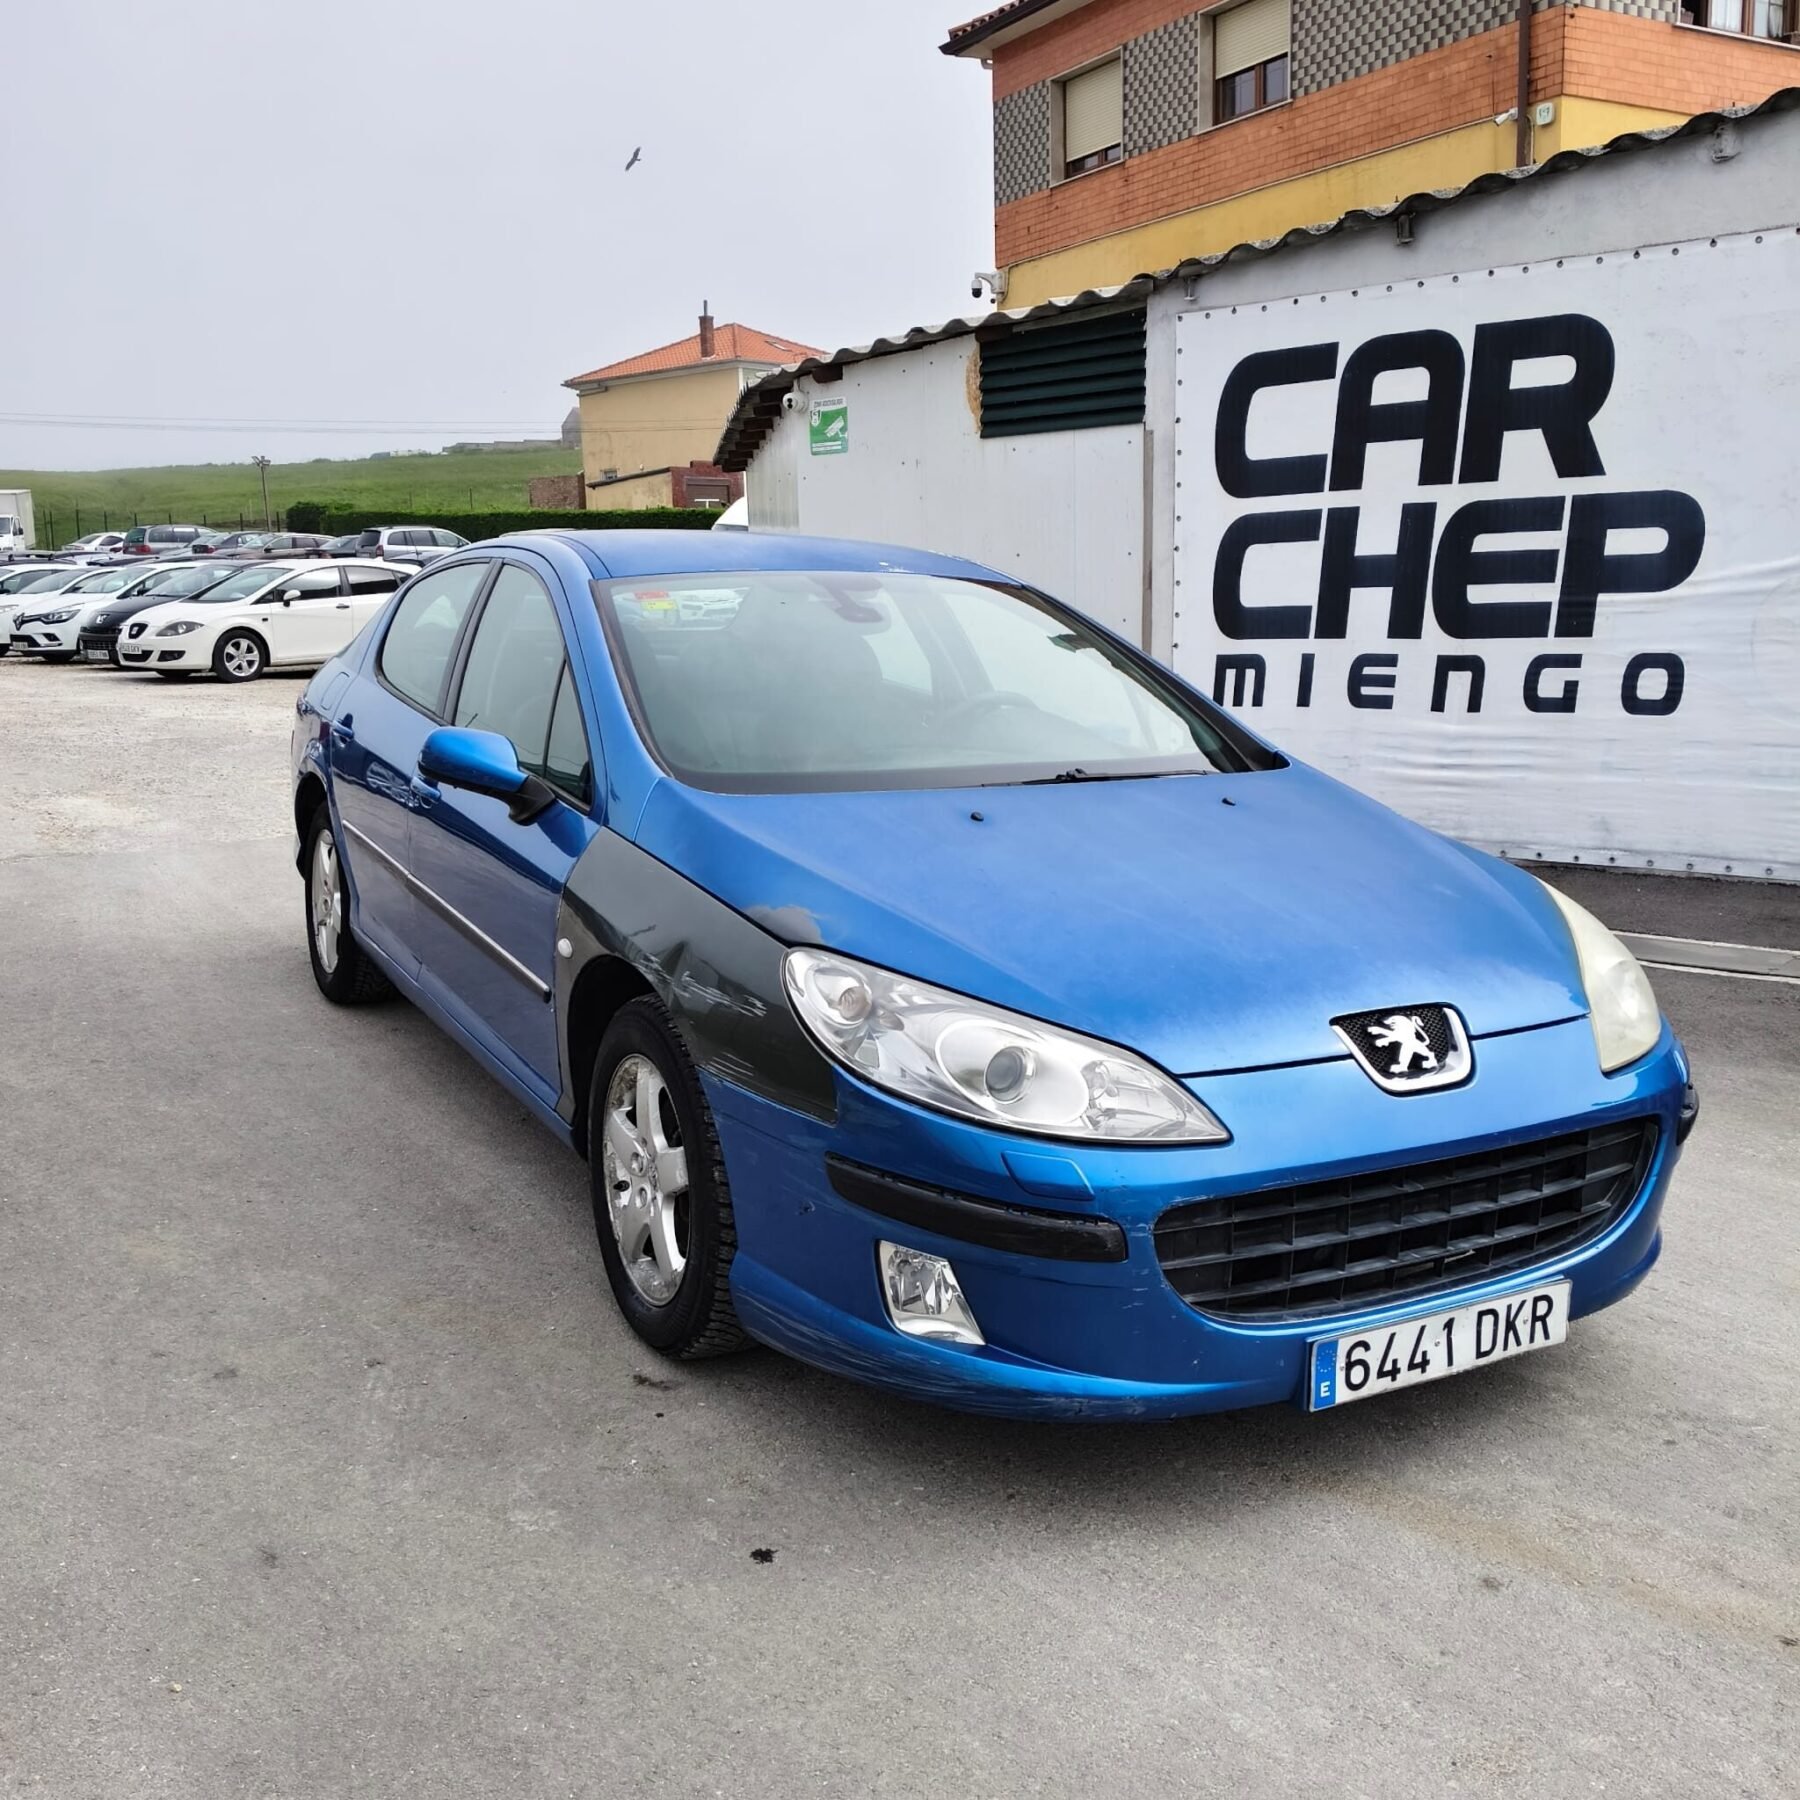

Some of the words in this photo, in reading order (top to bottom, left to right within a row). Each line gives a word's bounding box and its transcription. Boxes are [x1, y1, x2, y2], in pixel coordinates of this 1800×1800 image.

[1214, 313, 1615, 499] CAR
[1212, 489, 1706, 640] CHEP
[1212, 652, 1685, 716] MIENGO
[1319, 1381, 1331, 1398] E
[1344, 1316, 1455, 1392] 6441
[1475, 1294, 1555, 1360] DKR
